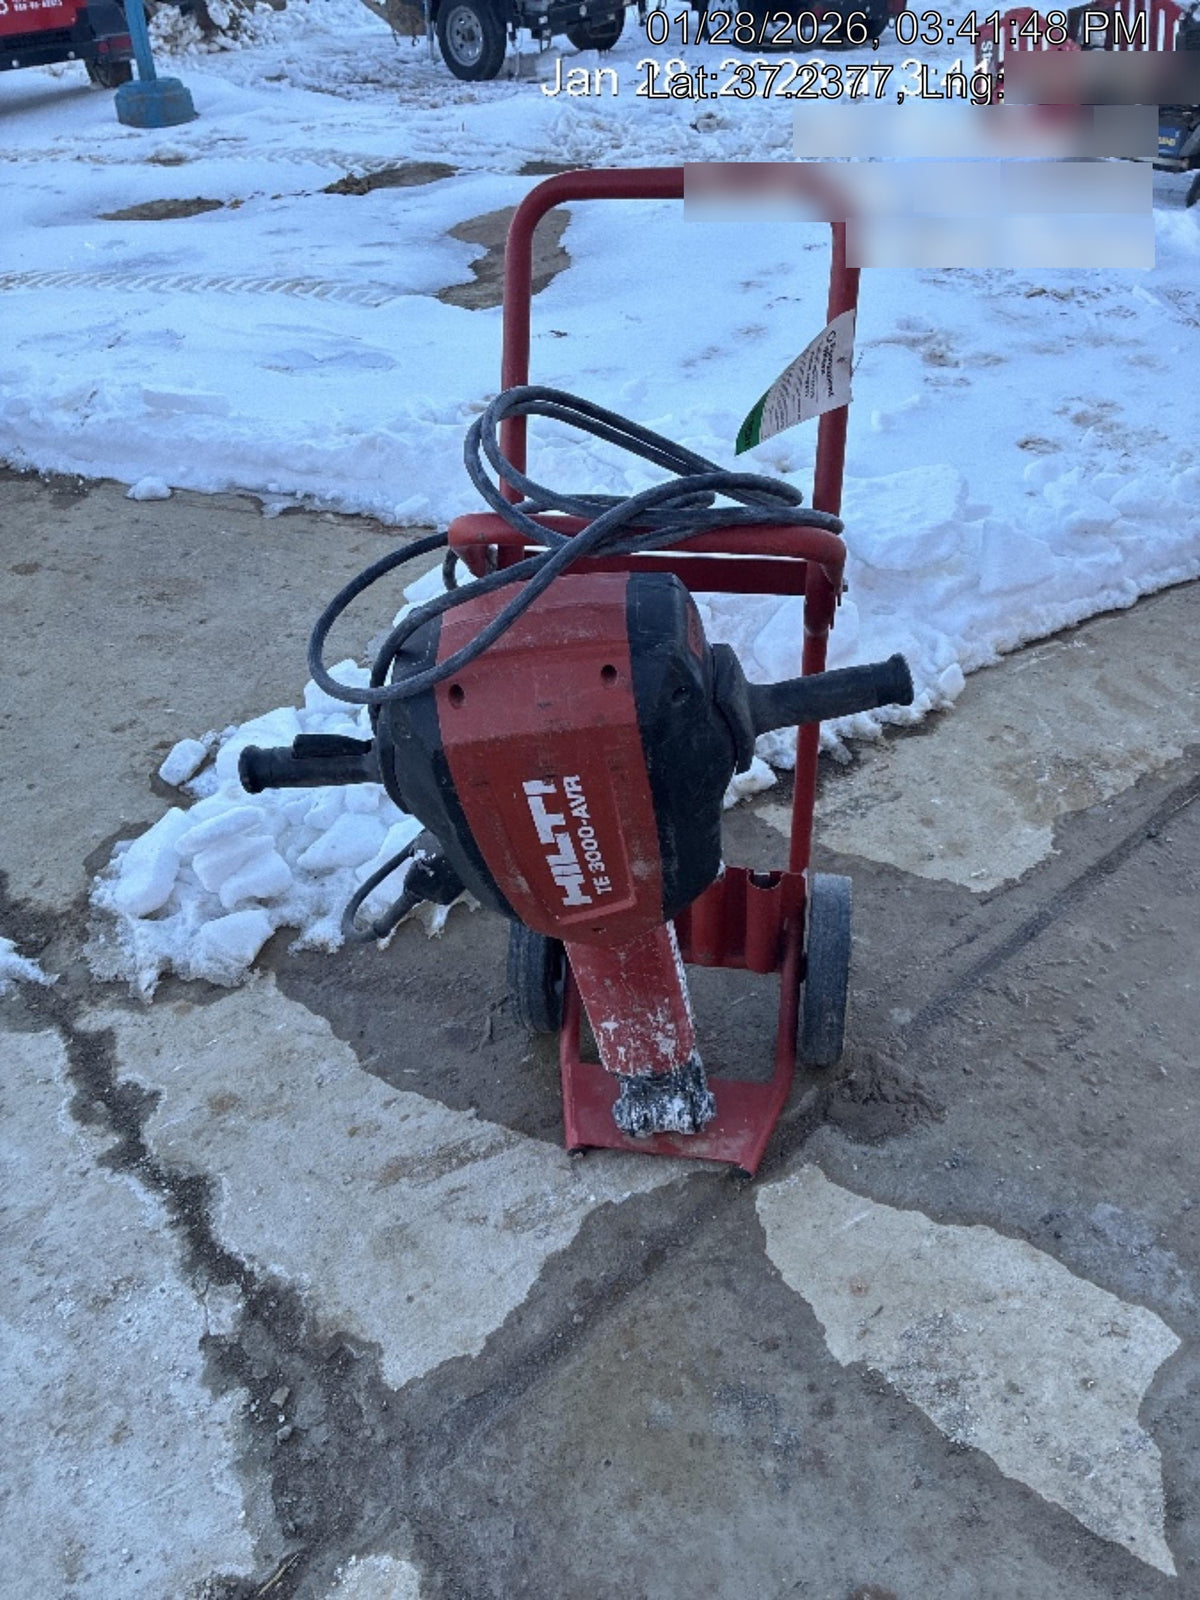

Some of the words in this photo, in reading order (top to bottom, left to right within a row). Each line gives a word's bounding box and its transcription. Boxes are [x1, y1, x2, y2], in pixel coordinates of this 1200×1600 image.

[522, 780, 593, 906] HILTI
[563, 775, 606, 874] 3000-AVR
[593, 876, 612, 895] TE
